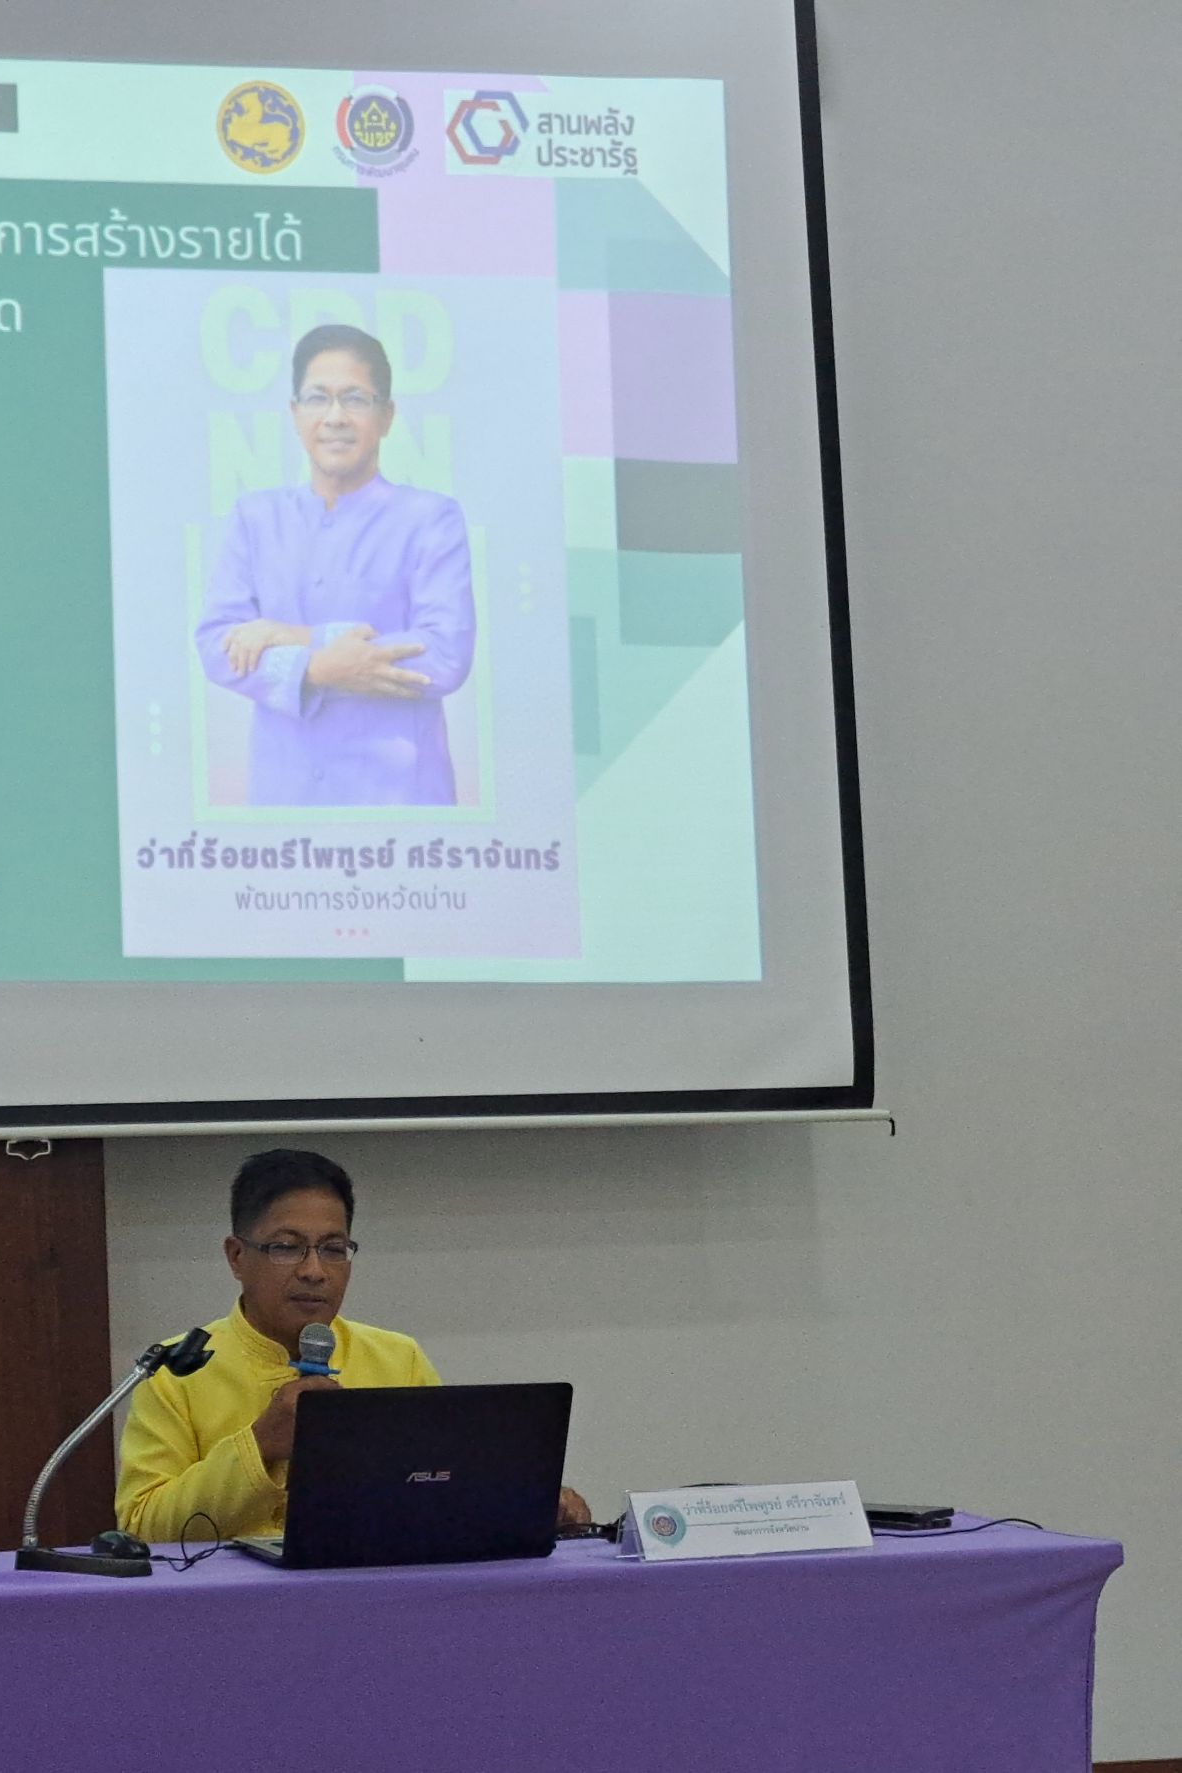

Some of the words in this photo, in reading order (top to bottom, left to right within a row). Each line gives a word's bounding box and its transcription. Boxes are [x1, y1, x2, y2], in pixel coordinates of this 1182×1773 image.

[537, 106, 635, 136] สานพลัง
[536, 138, 639, 176] ประชารัฐ
[406, 837, 563, 872] ศรีราจันทร์
[234, 884, 467, 911] พัฒนาการจังหวัดน่าน
[406, 1470, 451, 1482] ASUS
